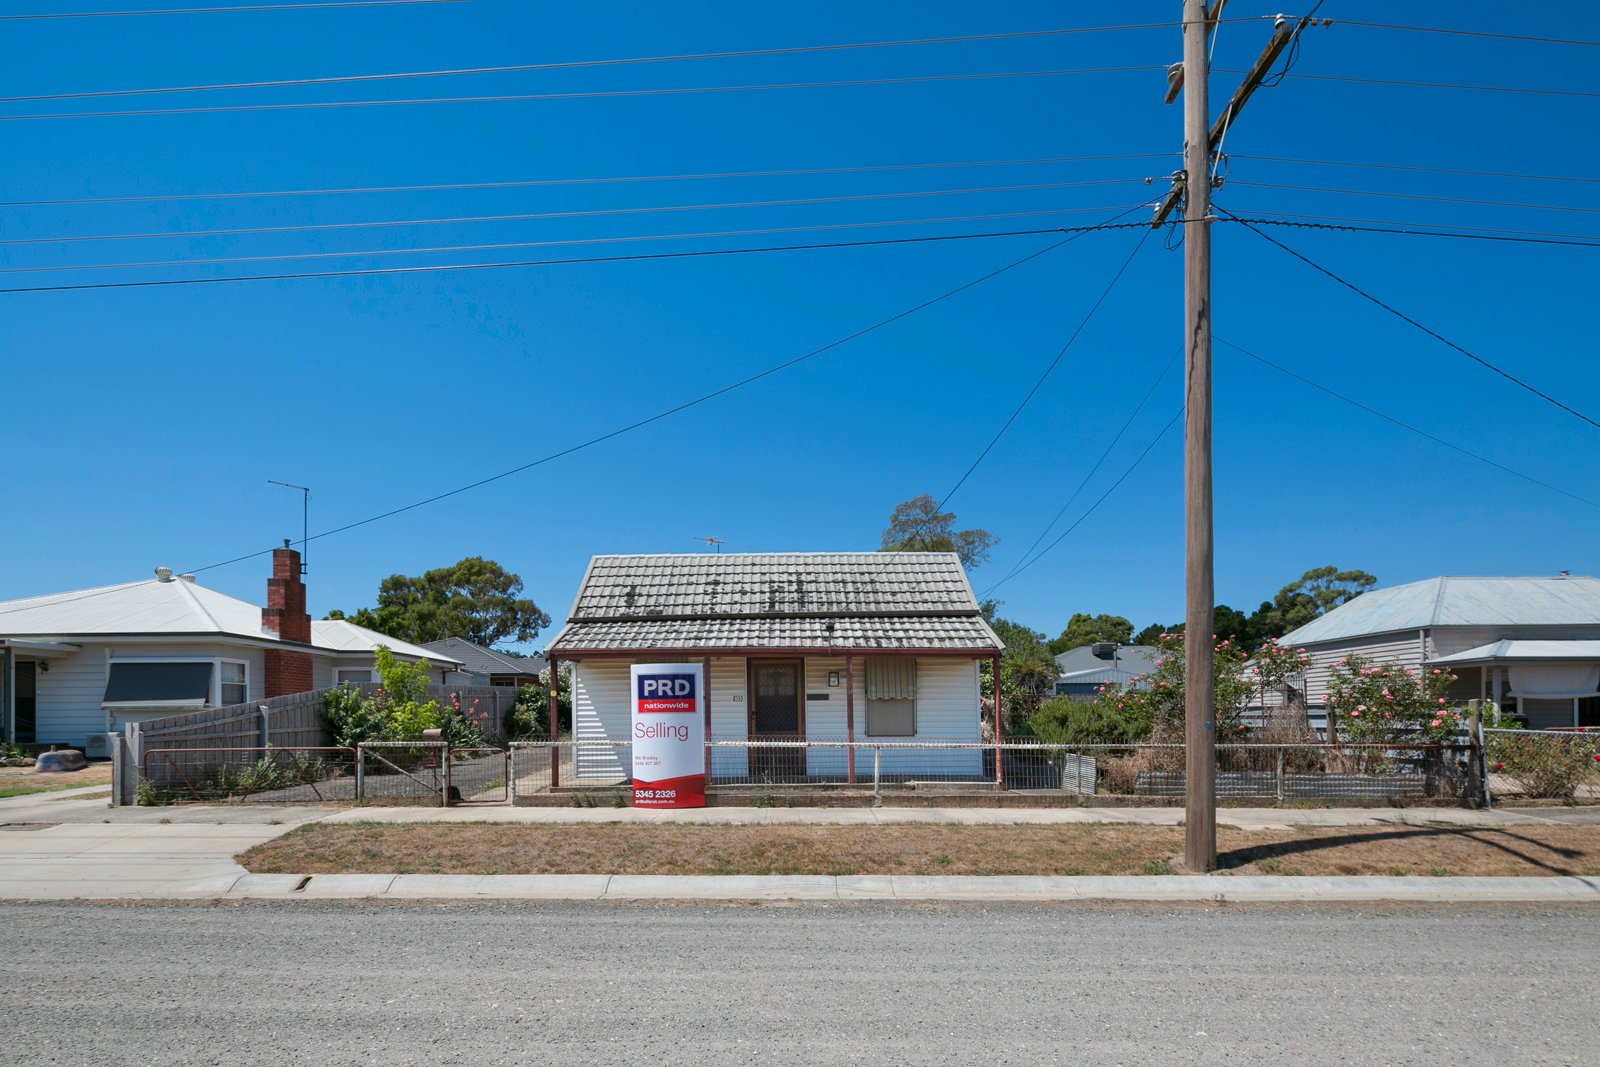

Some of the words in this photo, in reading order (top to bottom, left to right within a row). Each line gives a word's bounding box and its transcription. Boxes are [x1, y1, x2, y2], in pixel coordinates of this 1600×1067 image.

[643, 679, 691, 696] PRD
[635, 722, 689, 741] Selling
[635, 790, 654, 798] 5345
[655, 790, 676, 798] 2326
